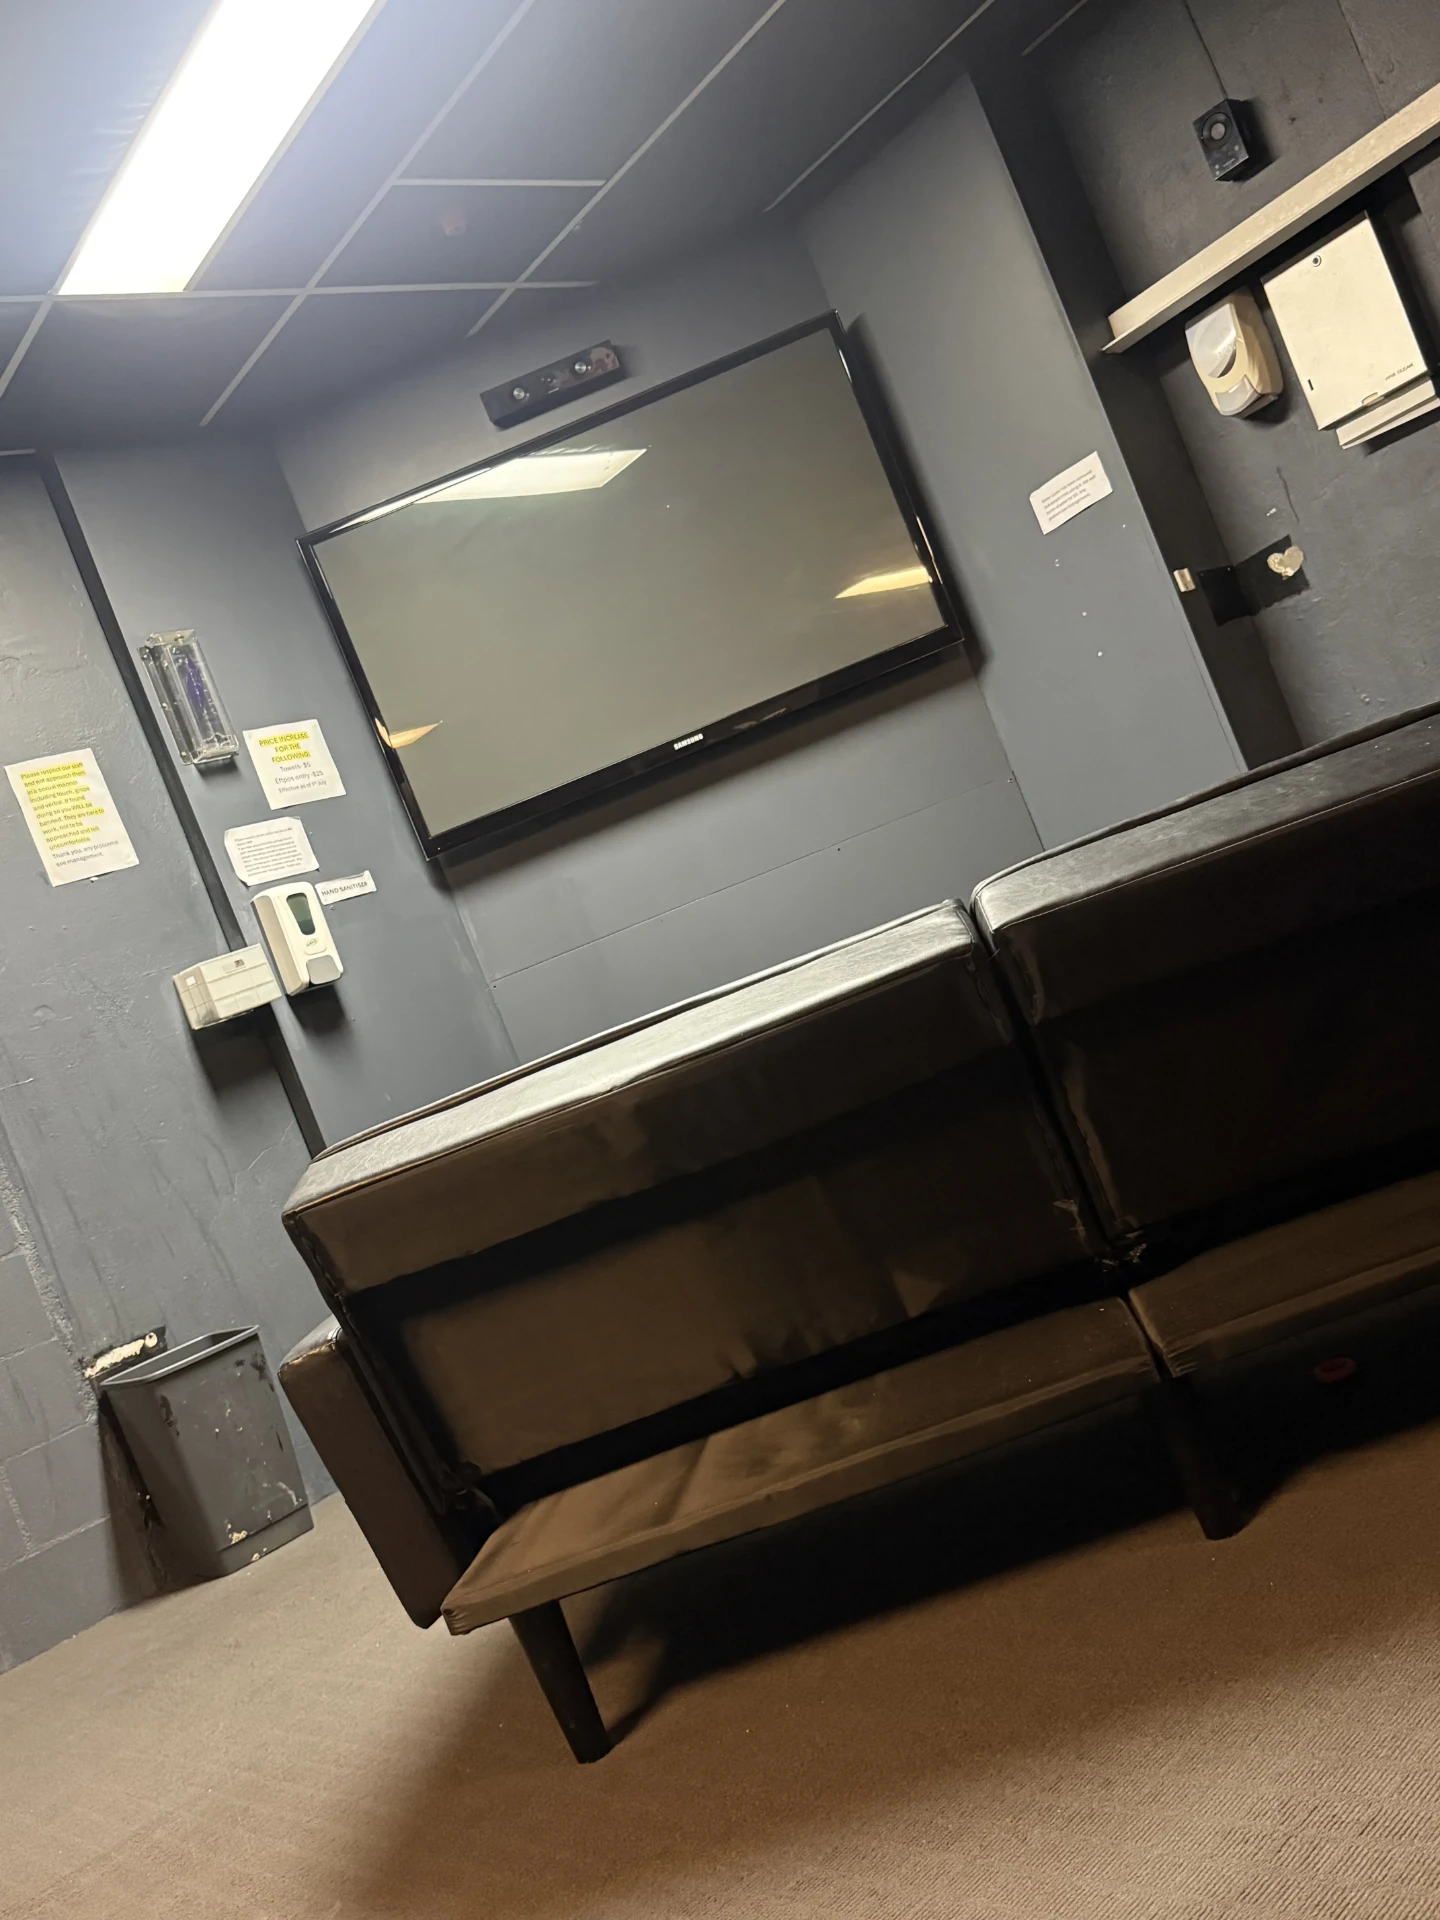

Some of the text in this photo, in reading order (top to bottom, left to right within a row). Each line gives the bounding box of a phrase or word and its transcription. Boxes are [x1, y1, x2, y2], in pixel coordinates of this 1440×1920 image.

[259, 732, 309, 747] PRICE INCREASE
[673, 733, 703, 750] SAMSUNG
[274, 745, 289, 753] FOR
[20, 772, 40, 780] Please
[40, 767, 62, 775] respect
[46, 773, 72, 782] approach
[275, 776, 295, 784] Eftpos
[38, 784, 57, 793] sexual
[57, 780, 78, 788] manner
[278, 785, 299, 793] Effective
[30, 793, 57, 803] including
[36, 811, 53, 819] doing
[39, 817, 63, 827] banned.
[46, 830, 80, 842] approached
[52, 851, 71, 859] Thank
[93, 840, 119, 851] problems
[321, 881, 368, 896] HAND SANITISER
